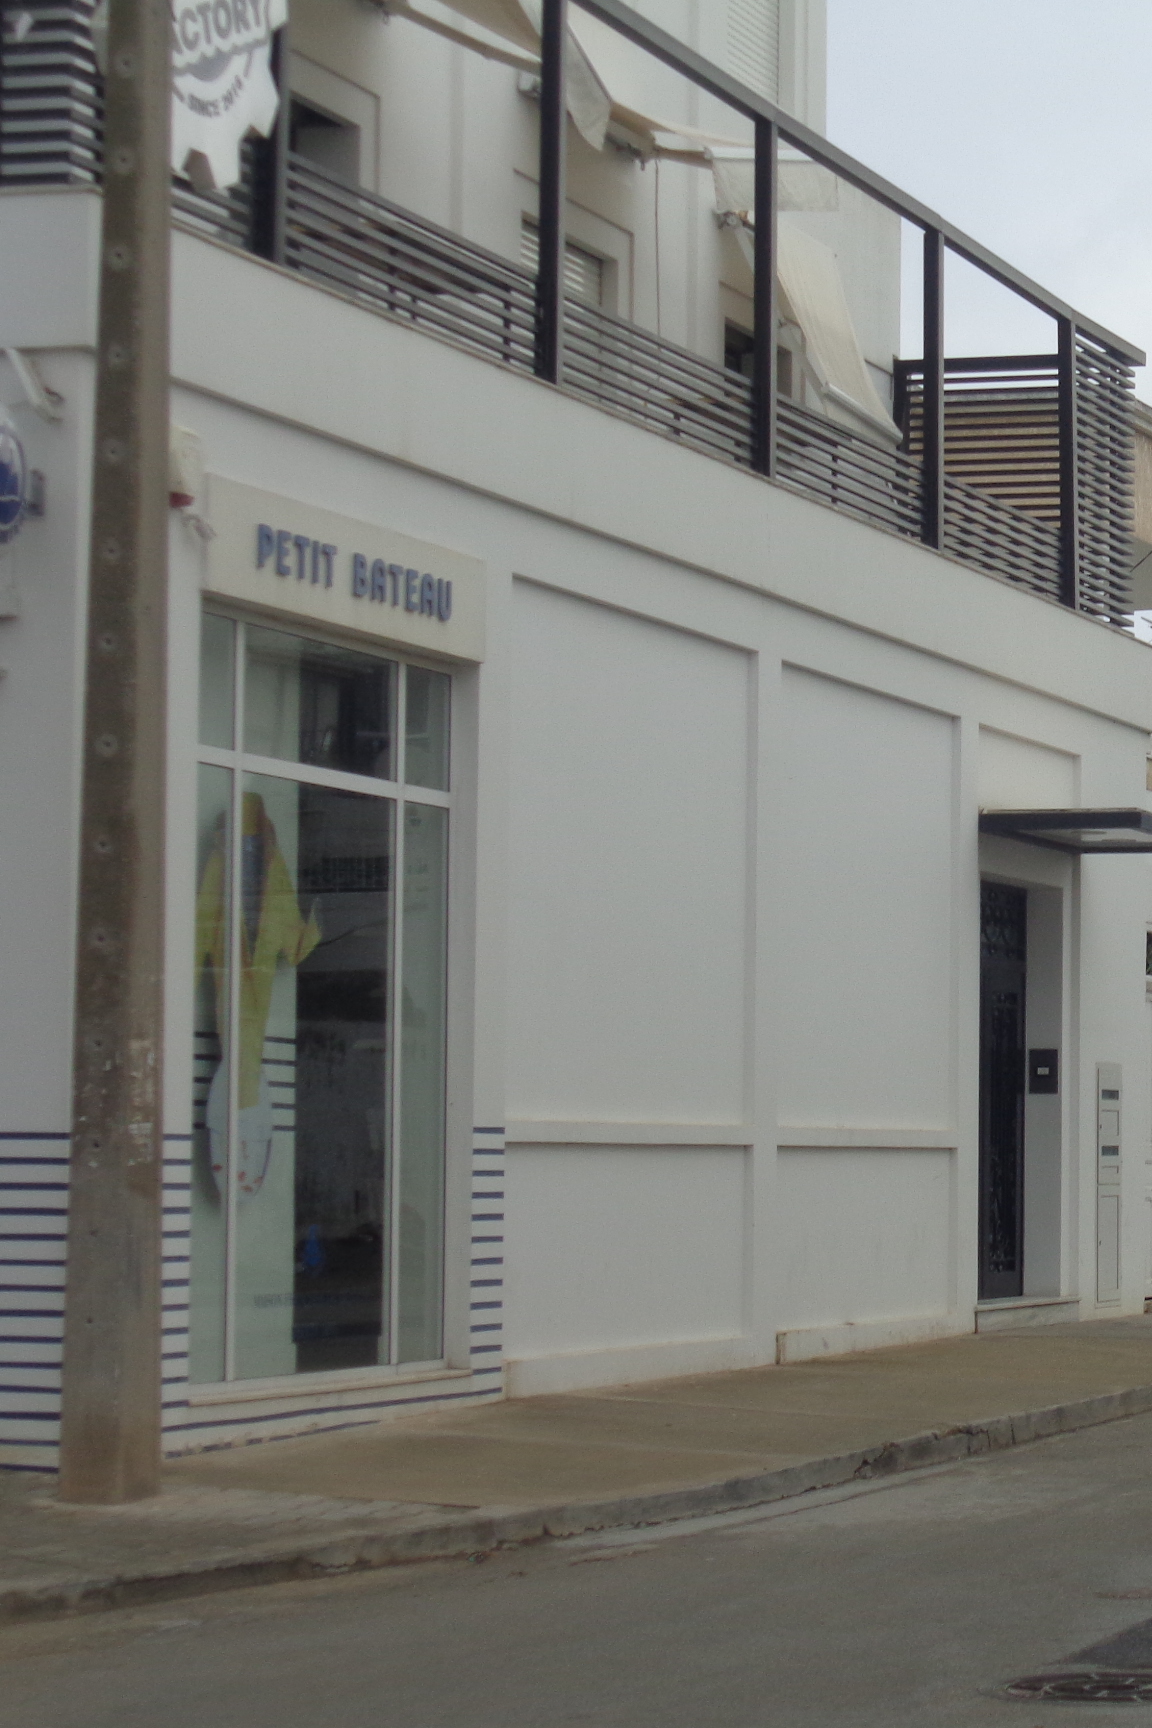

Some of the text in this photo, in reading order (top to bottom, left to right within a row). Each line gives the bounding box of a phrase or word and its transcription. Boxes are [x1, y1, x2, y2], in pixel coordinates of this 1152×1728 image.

[186, 92, 221, 118] SINCE
[256, 523, 453, 622] PETIT BATEAU
